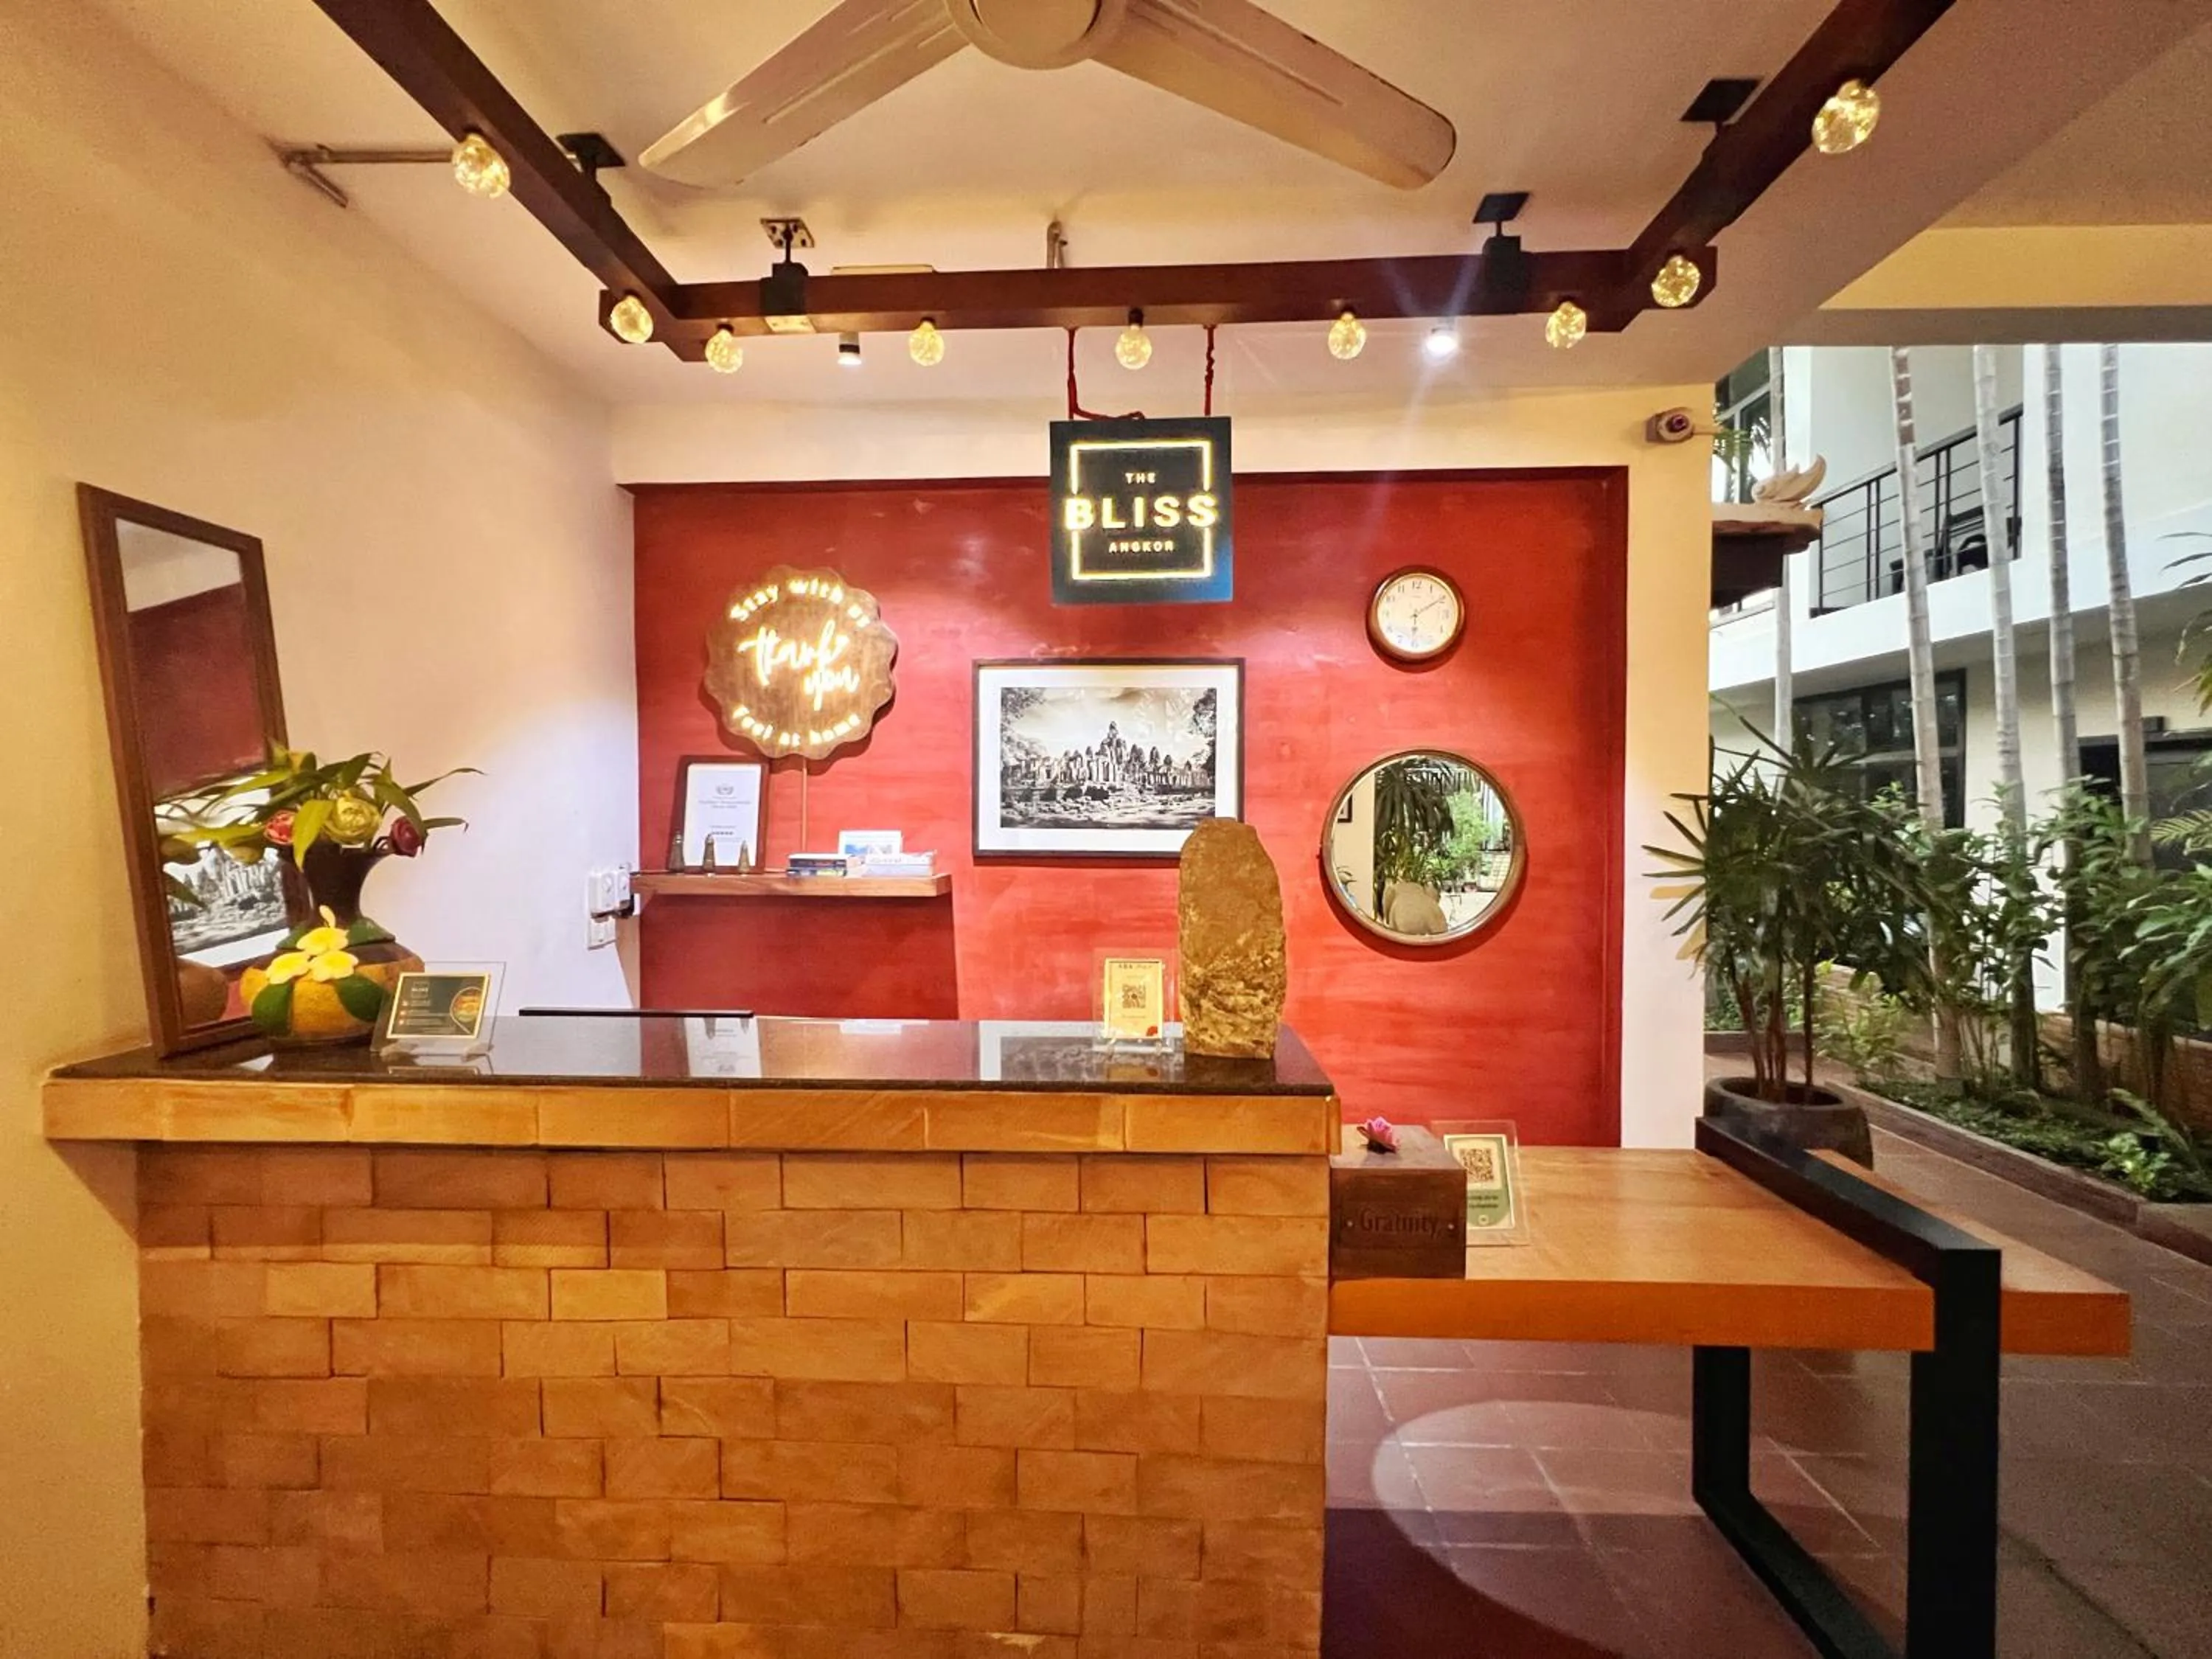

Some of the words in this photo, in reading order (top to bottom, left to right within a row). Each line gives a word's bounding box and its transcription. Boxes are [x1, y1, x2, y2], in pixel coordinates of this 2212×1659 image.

[1124, 472, 1156, 484] THE
[1063, 495, 1217, 530] BLISS
[1108, 540, 1175, 553] ANGKOR
[1360, 1208, 1438, 1239] Gratuity
